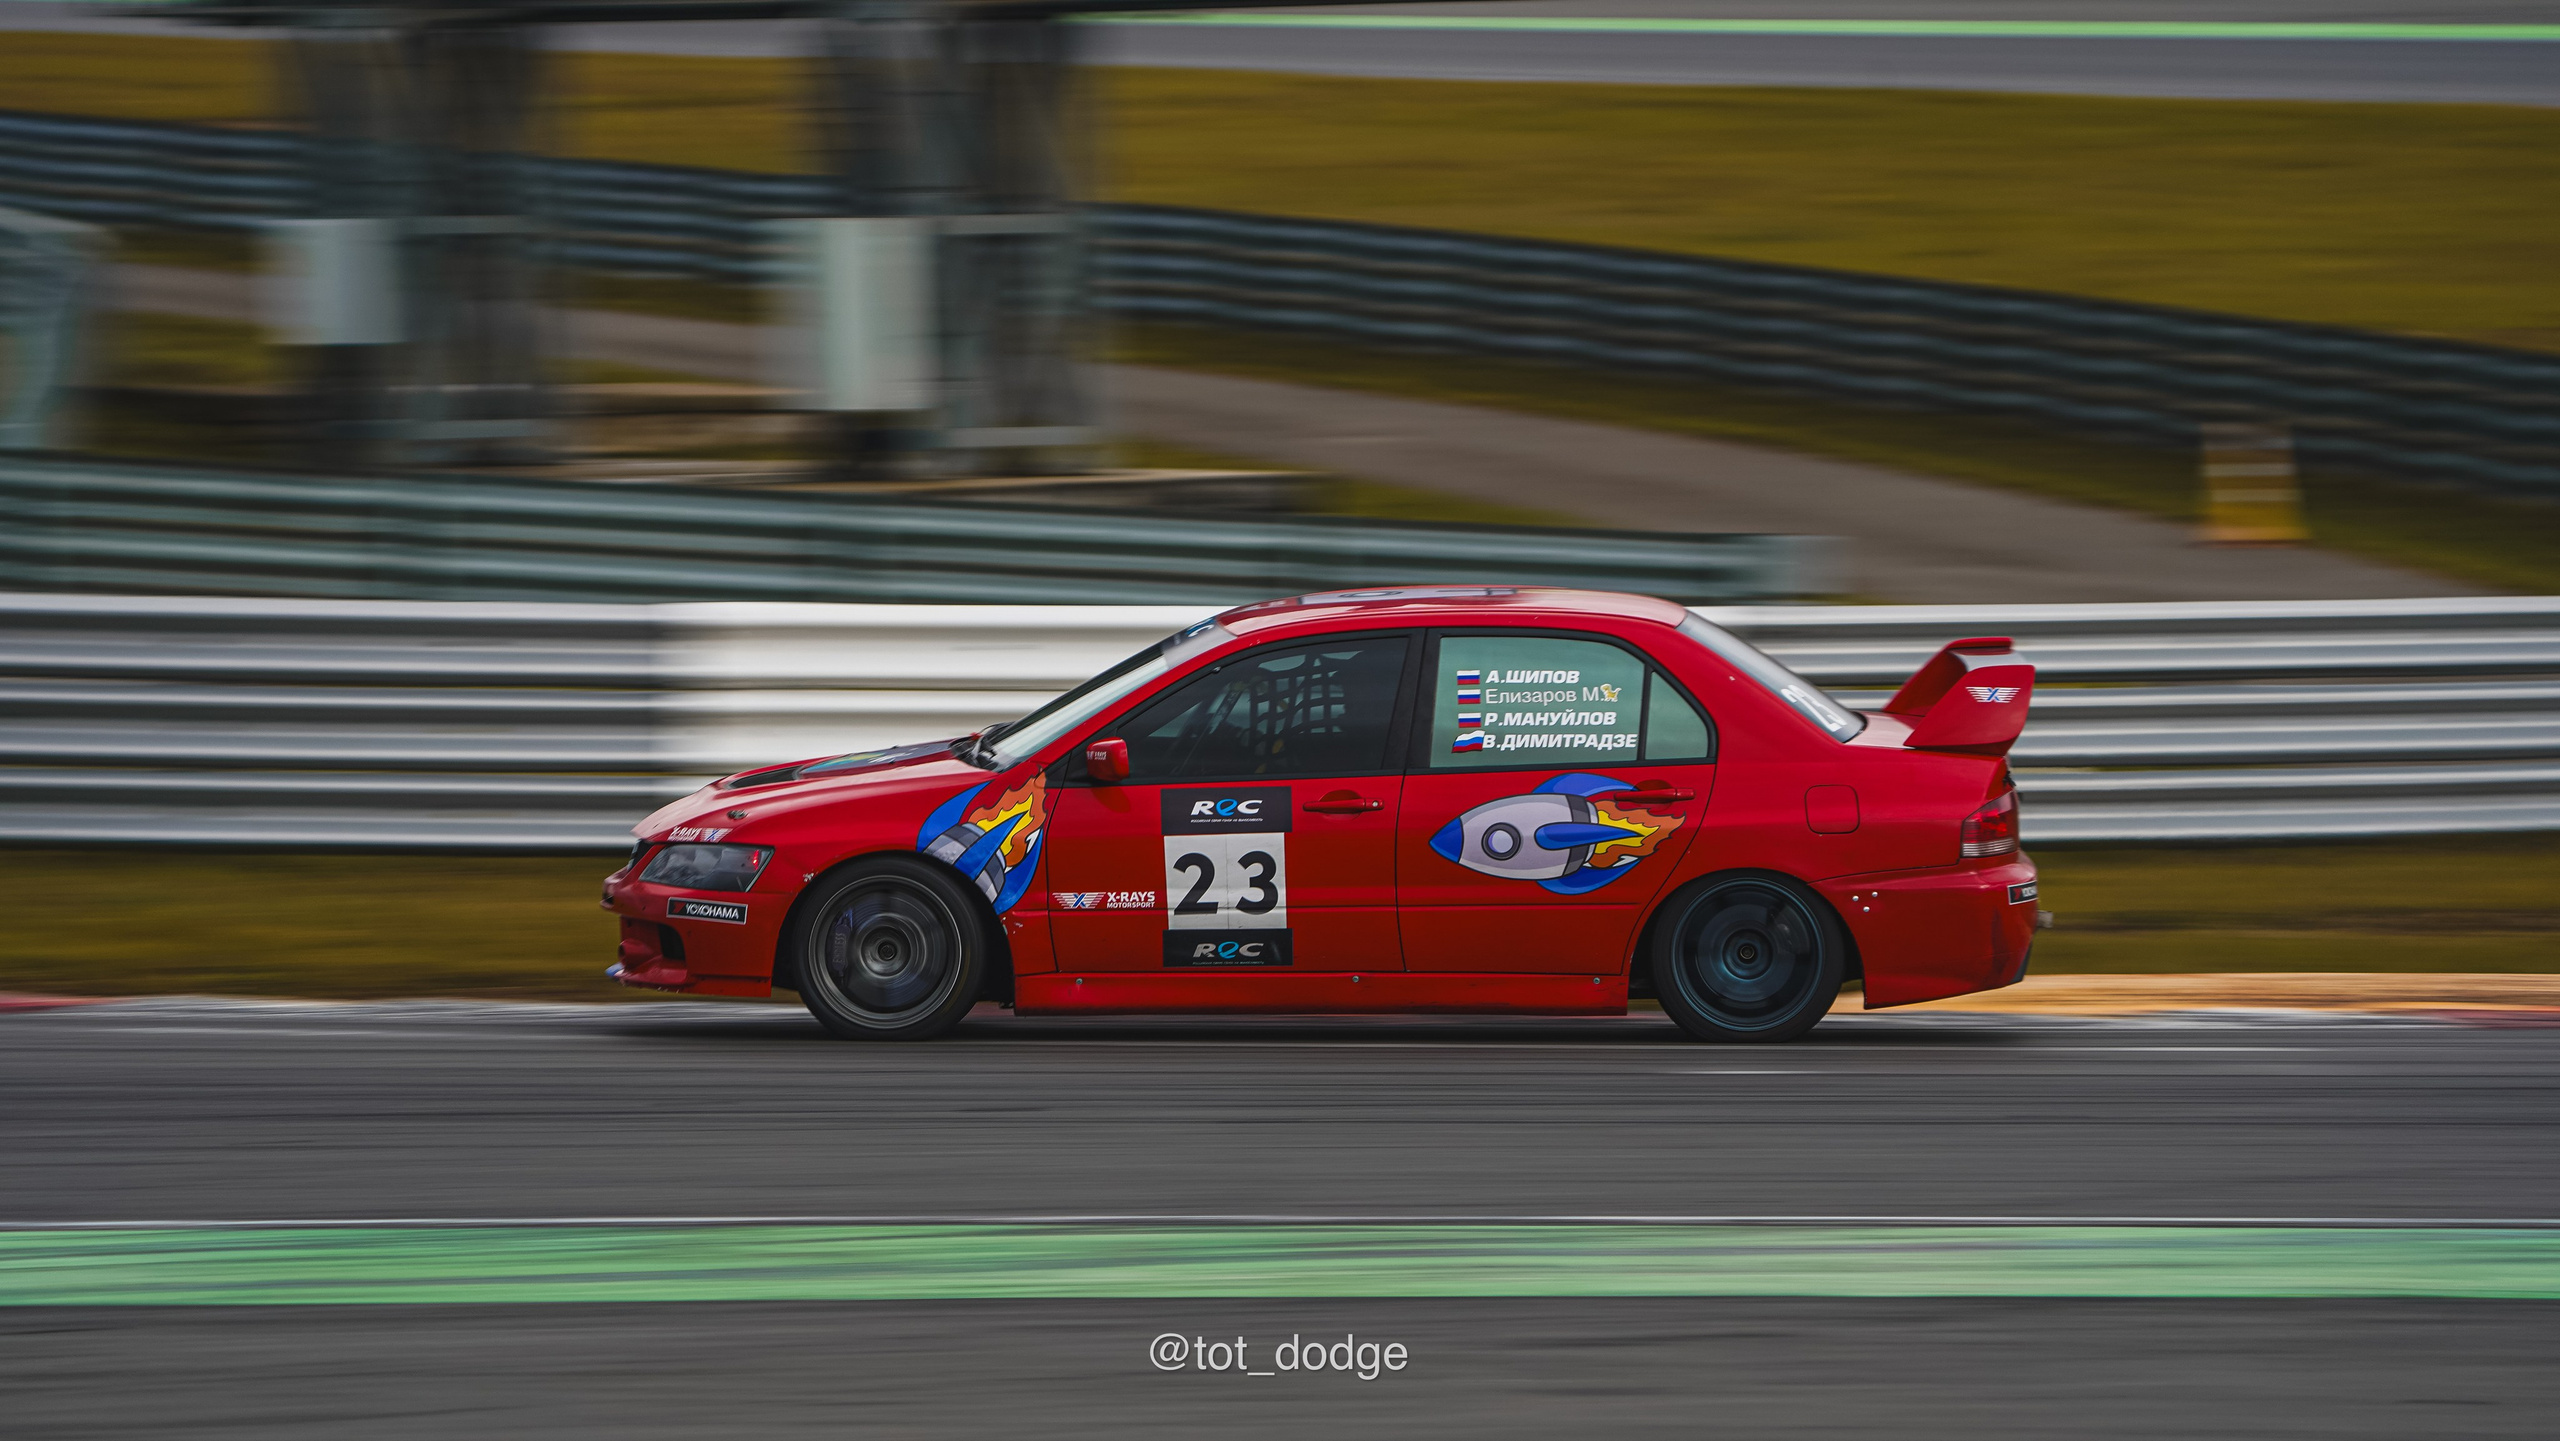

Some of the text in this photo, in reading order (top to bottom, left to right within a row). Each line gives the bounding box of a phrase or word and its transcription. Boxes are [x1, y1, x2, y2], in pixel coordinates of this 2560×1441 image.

[1485, 670, 1580, 684] А.ШИПОВ
[1485, 688, 1577, 706] Елизаров
[1484, 708, 1617, 727] Р.МАНУЙЛОВ
[1482, 733, 1638, 751] В.ДИМИТРАДЗЕ
[1173, 850, 1279, 916] 23
[1106, 901, 1155, 909] MOTORSPORT
[1107, 891, 1155, 902] X-RAYS
[686, 903, 739, 919] YOKOHAMA
